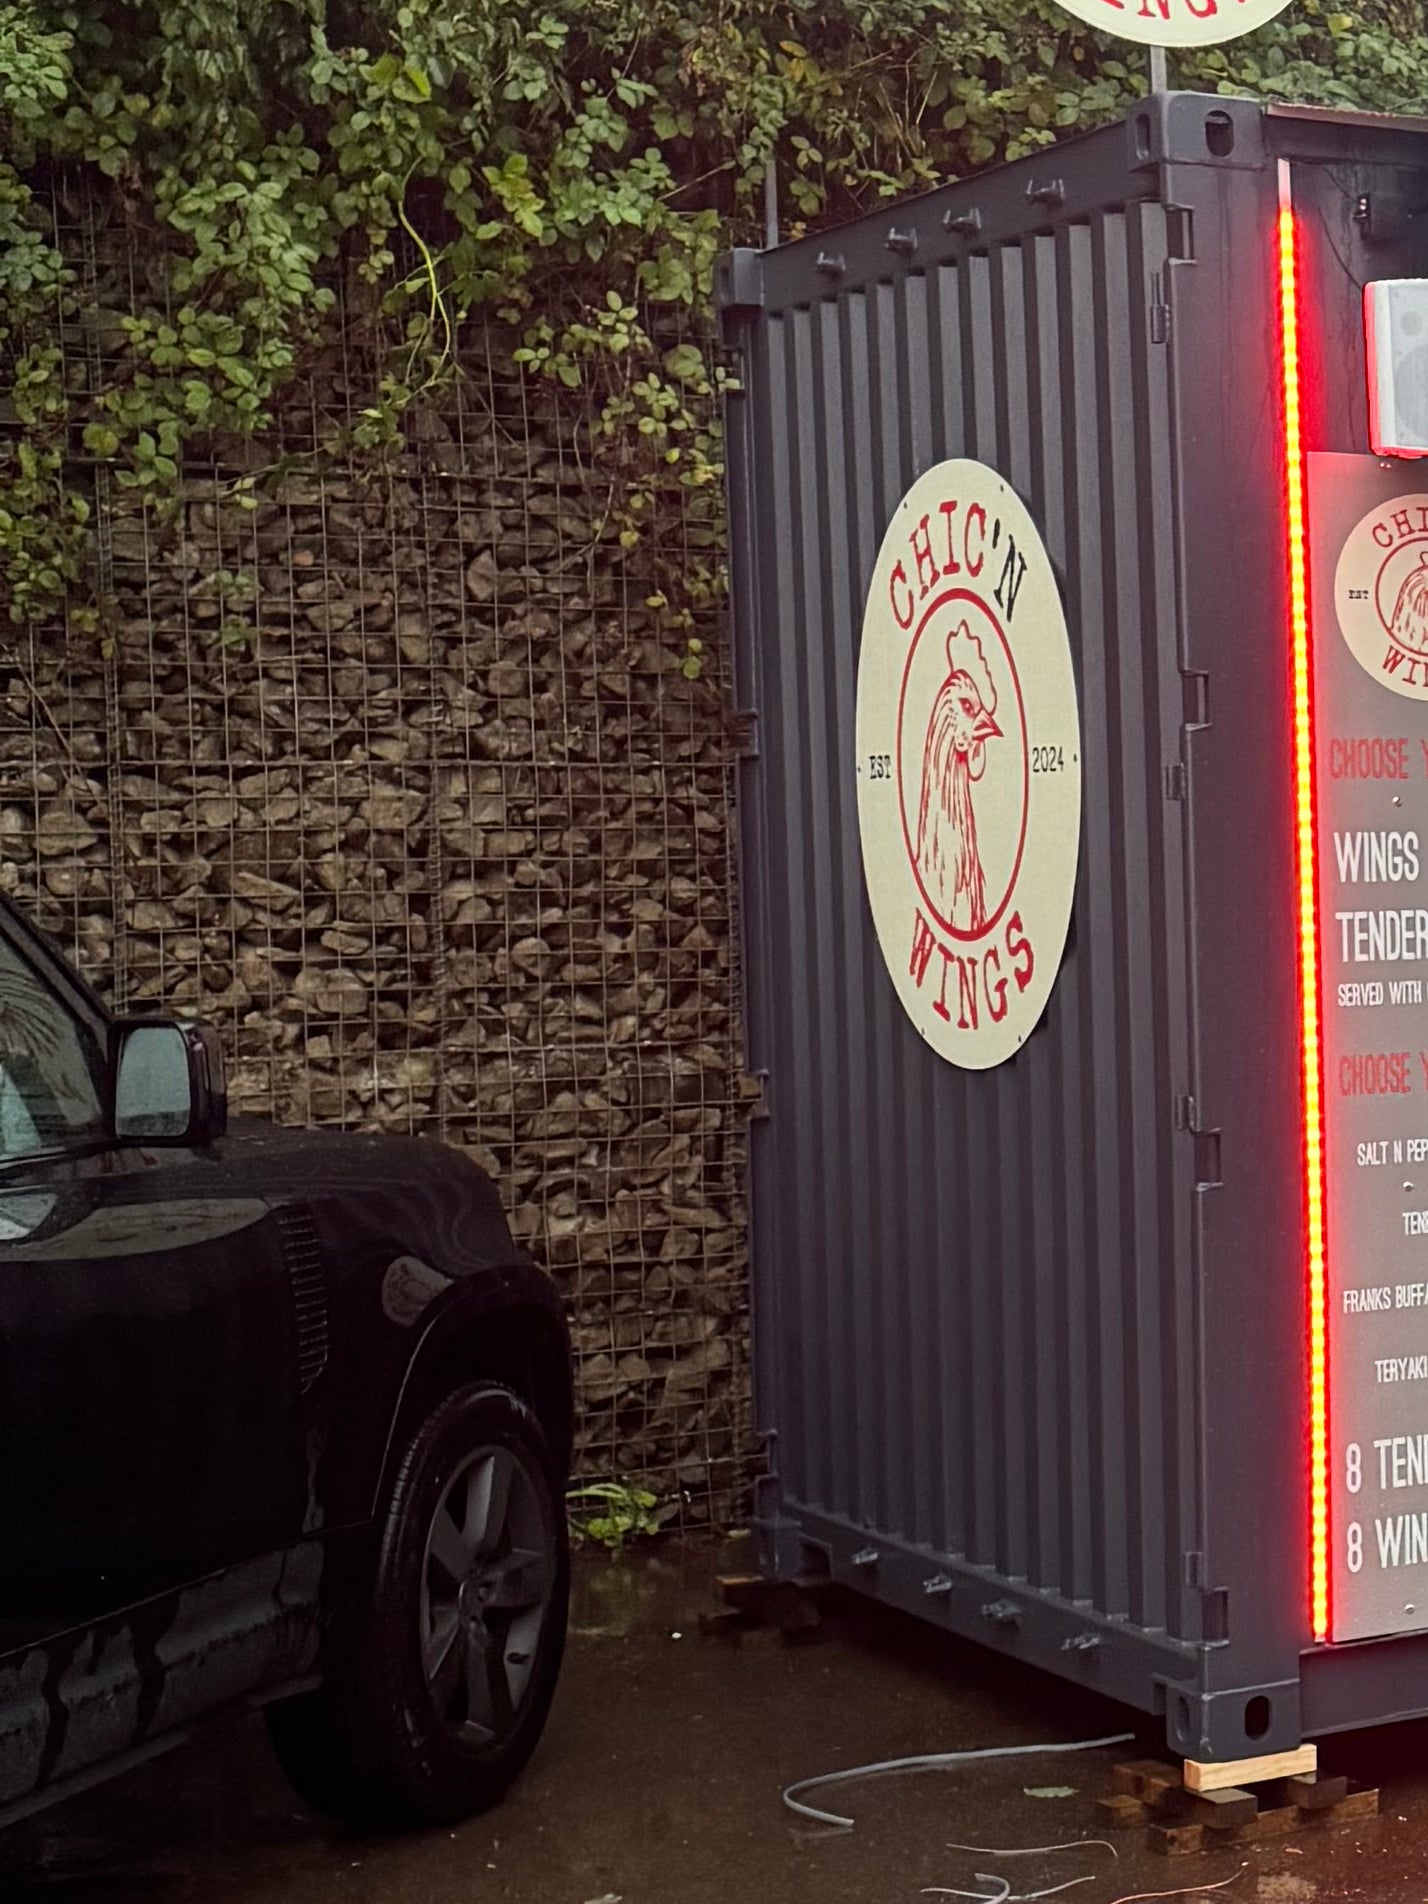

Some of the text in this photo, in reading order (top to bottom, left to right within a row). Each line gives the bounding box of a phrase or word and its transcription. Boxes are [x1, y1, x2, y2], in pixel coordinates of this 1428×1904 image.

[889, 500, 1028, 630] CHIC'N
[869, 754, 891, 781] EST
[1032, 746, 1065, 773] 2024
[1330, 738, 1409, 779] CHOOSE
[1334, 831, 1419, 883] WINGS
[908, 907, 1034, 1030] WINGS
[1338, 982, 1383, 1007] SERVED
[1389, 980, 1422, 1004] WITH
[1339, 1052, 1411, 1096] CHOOSE
[1357, 1141, 1388, 1166] SALT
[1394, 1140, 1402, 1164] N
[1343, 1288, 1391, 1314] FRANKS
[1374, 1356, 1428, 1383] TERYAKI
[1345, 1443, 1362, 1493] 8
[1346, 1522, 1363, 1573] 8
